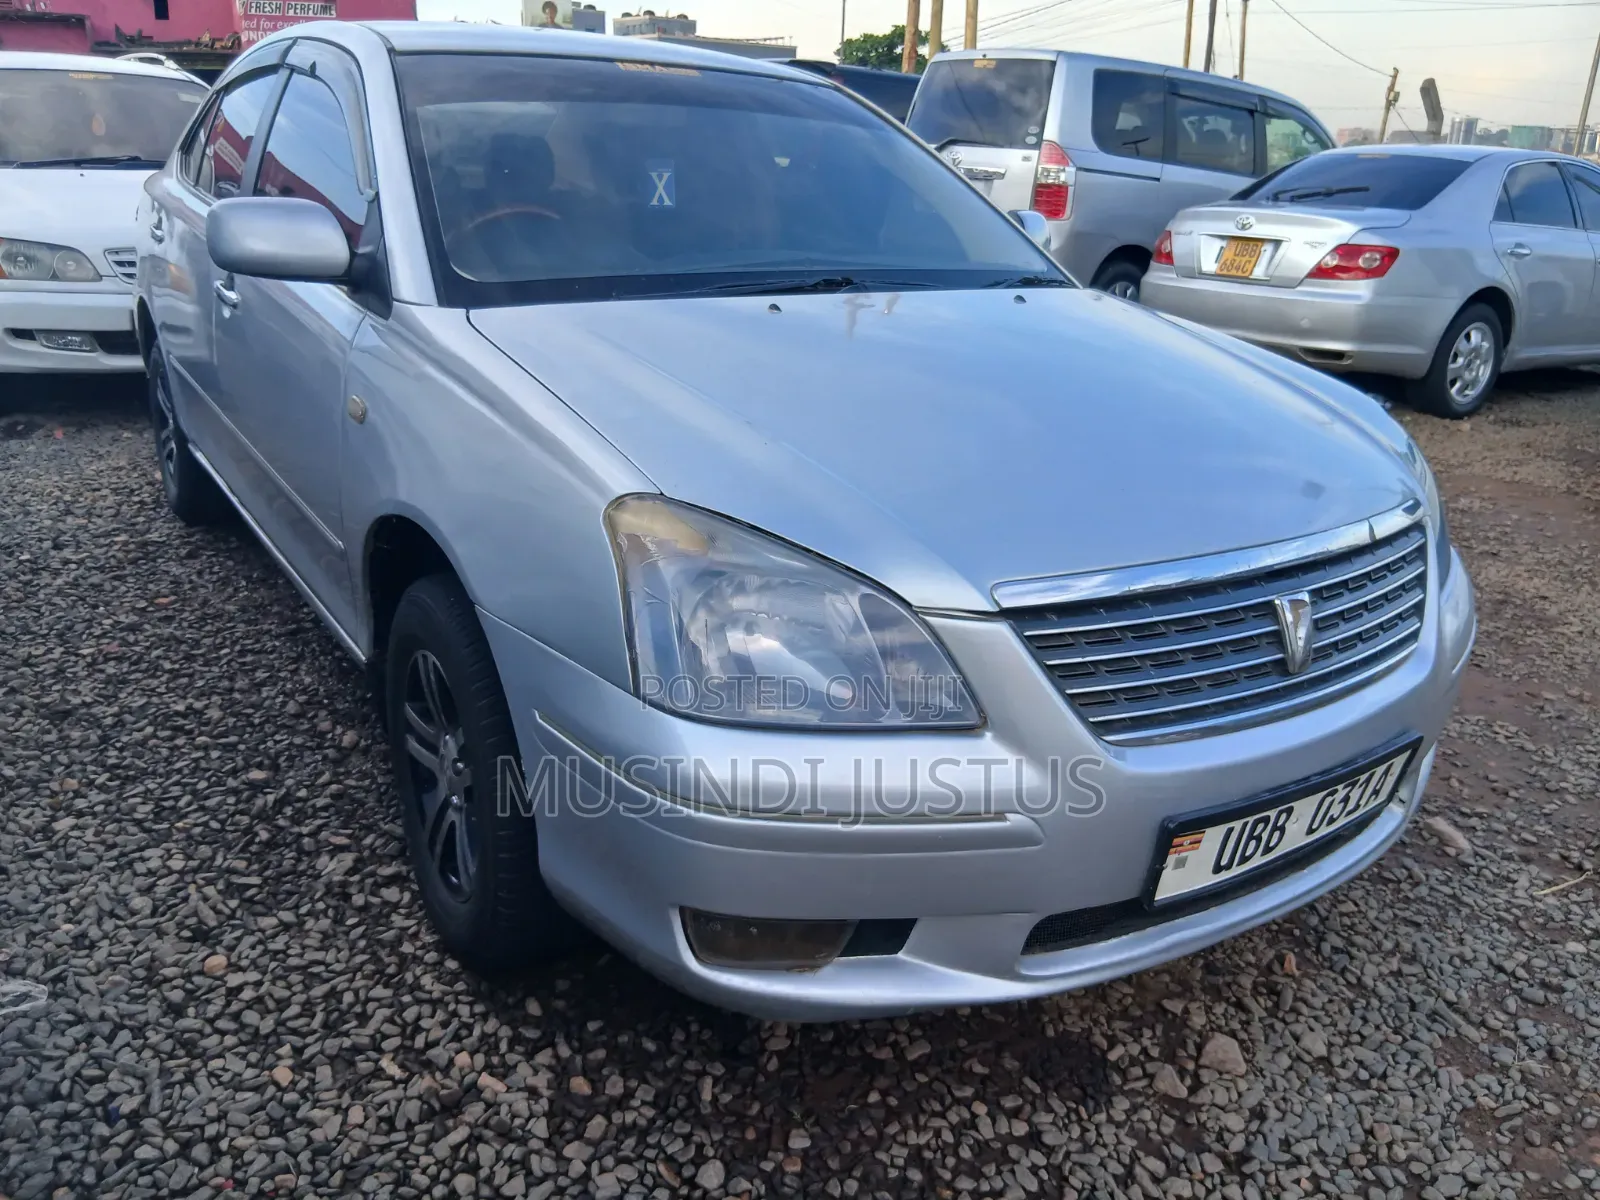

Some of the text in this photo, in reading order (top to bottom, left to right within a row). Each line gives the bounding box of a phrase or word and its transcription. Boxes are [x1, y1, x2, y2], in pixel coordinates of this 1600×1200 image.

[248, 1, 282, 15] FRESH
[286, 2, 335, 16] PERFUME
[260, 17, 275, 31] for
[648, 172, 674, 206] X
[1233, 241, 1259, 258] UBB
[1219, 258, 1252, 274] 684C
[1211, 760, 1396, 875] UBB 031A
